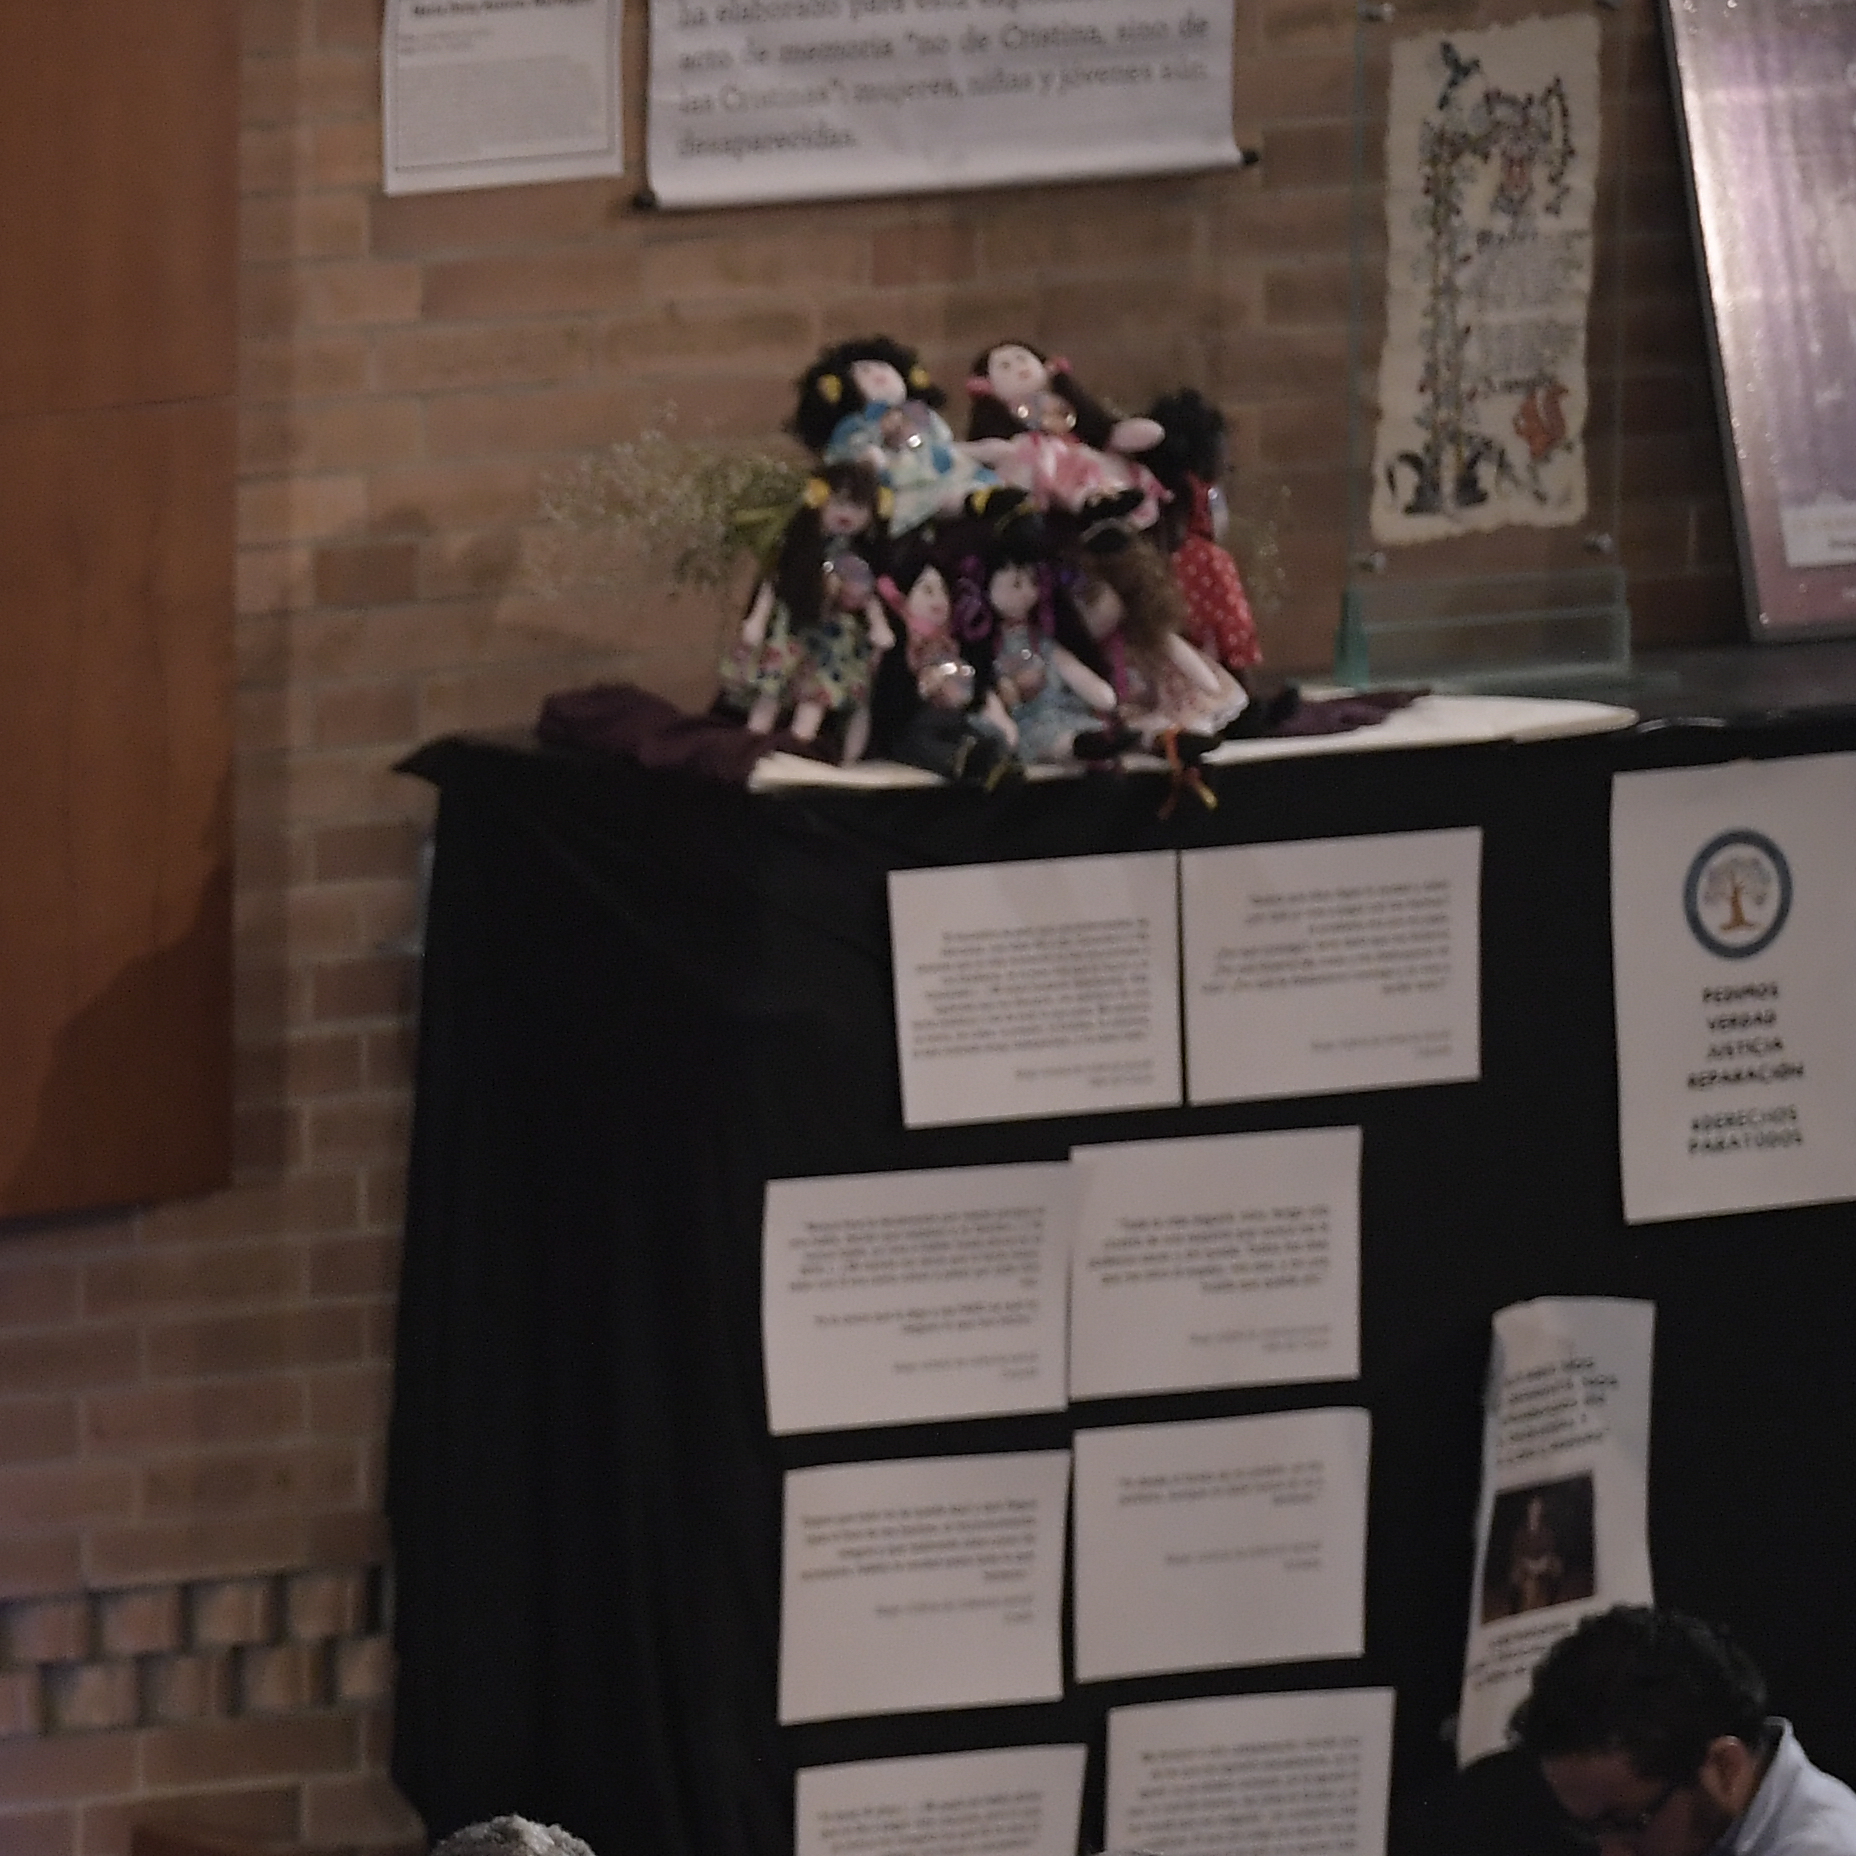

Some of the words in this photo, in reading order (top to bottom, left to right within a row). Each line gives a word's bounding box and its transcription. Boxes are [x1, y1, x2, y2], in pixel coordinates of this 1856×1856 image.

[779, 38, 893, 66] memoria
[959, 22, 990, 53] de
[1116, 18, 1168, 45] sino
[1179, 9, 1209, 39] de
[1702, 981, 1779, 1003] PEDIMOS
[1706, 1009, 1777, 1031] VERDAD
[1707, 1036, 1784, 1060] JUSTICIA
[1687, 1060, 1805, 1090] REPARACIÓN
